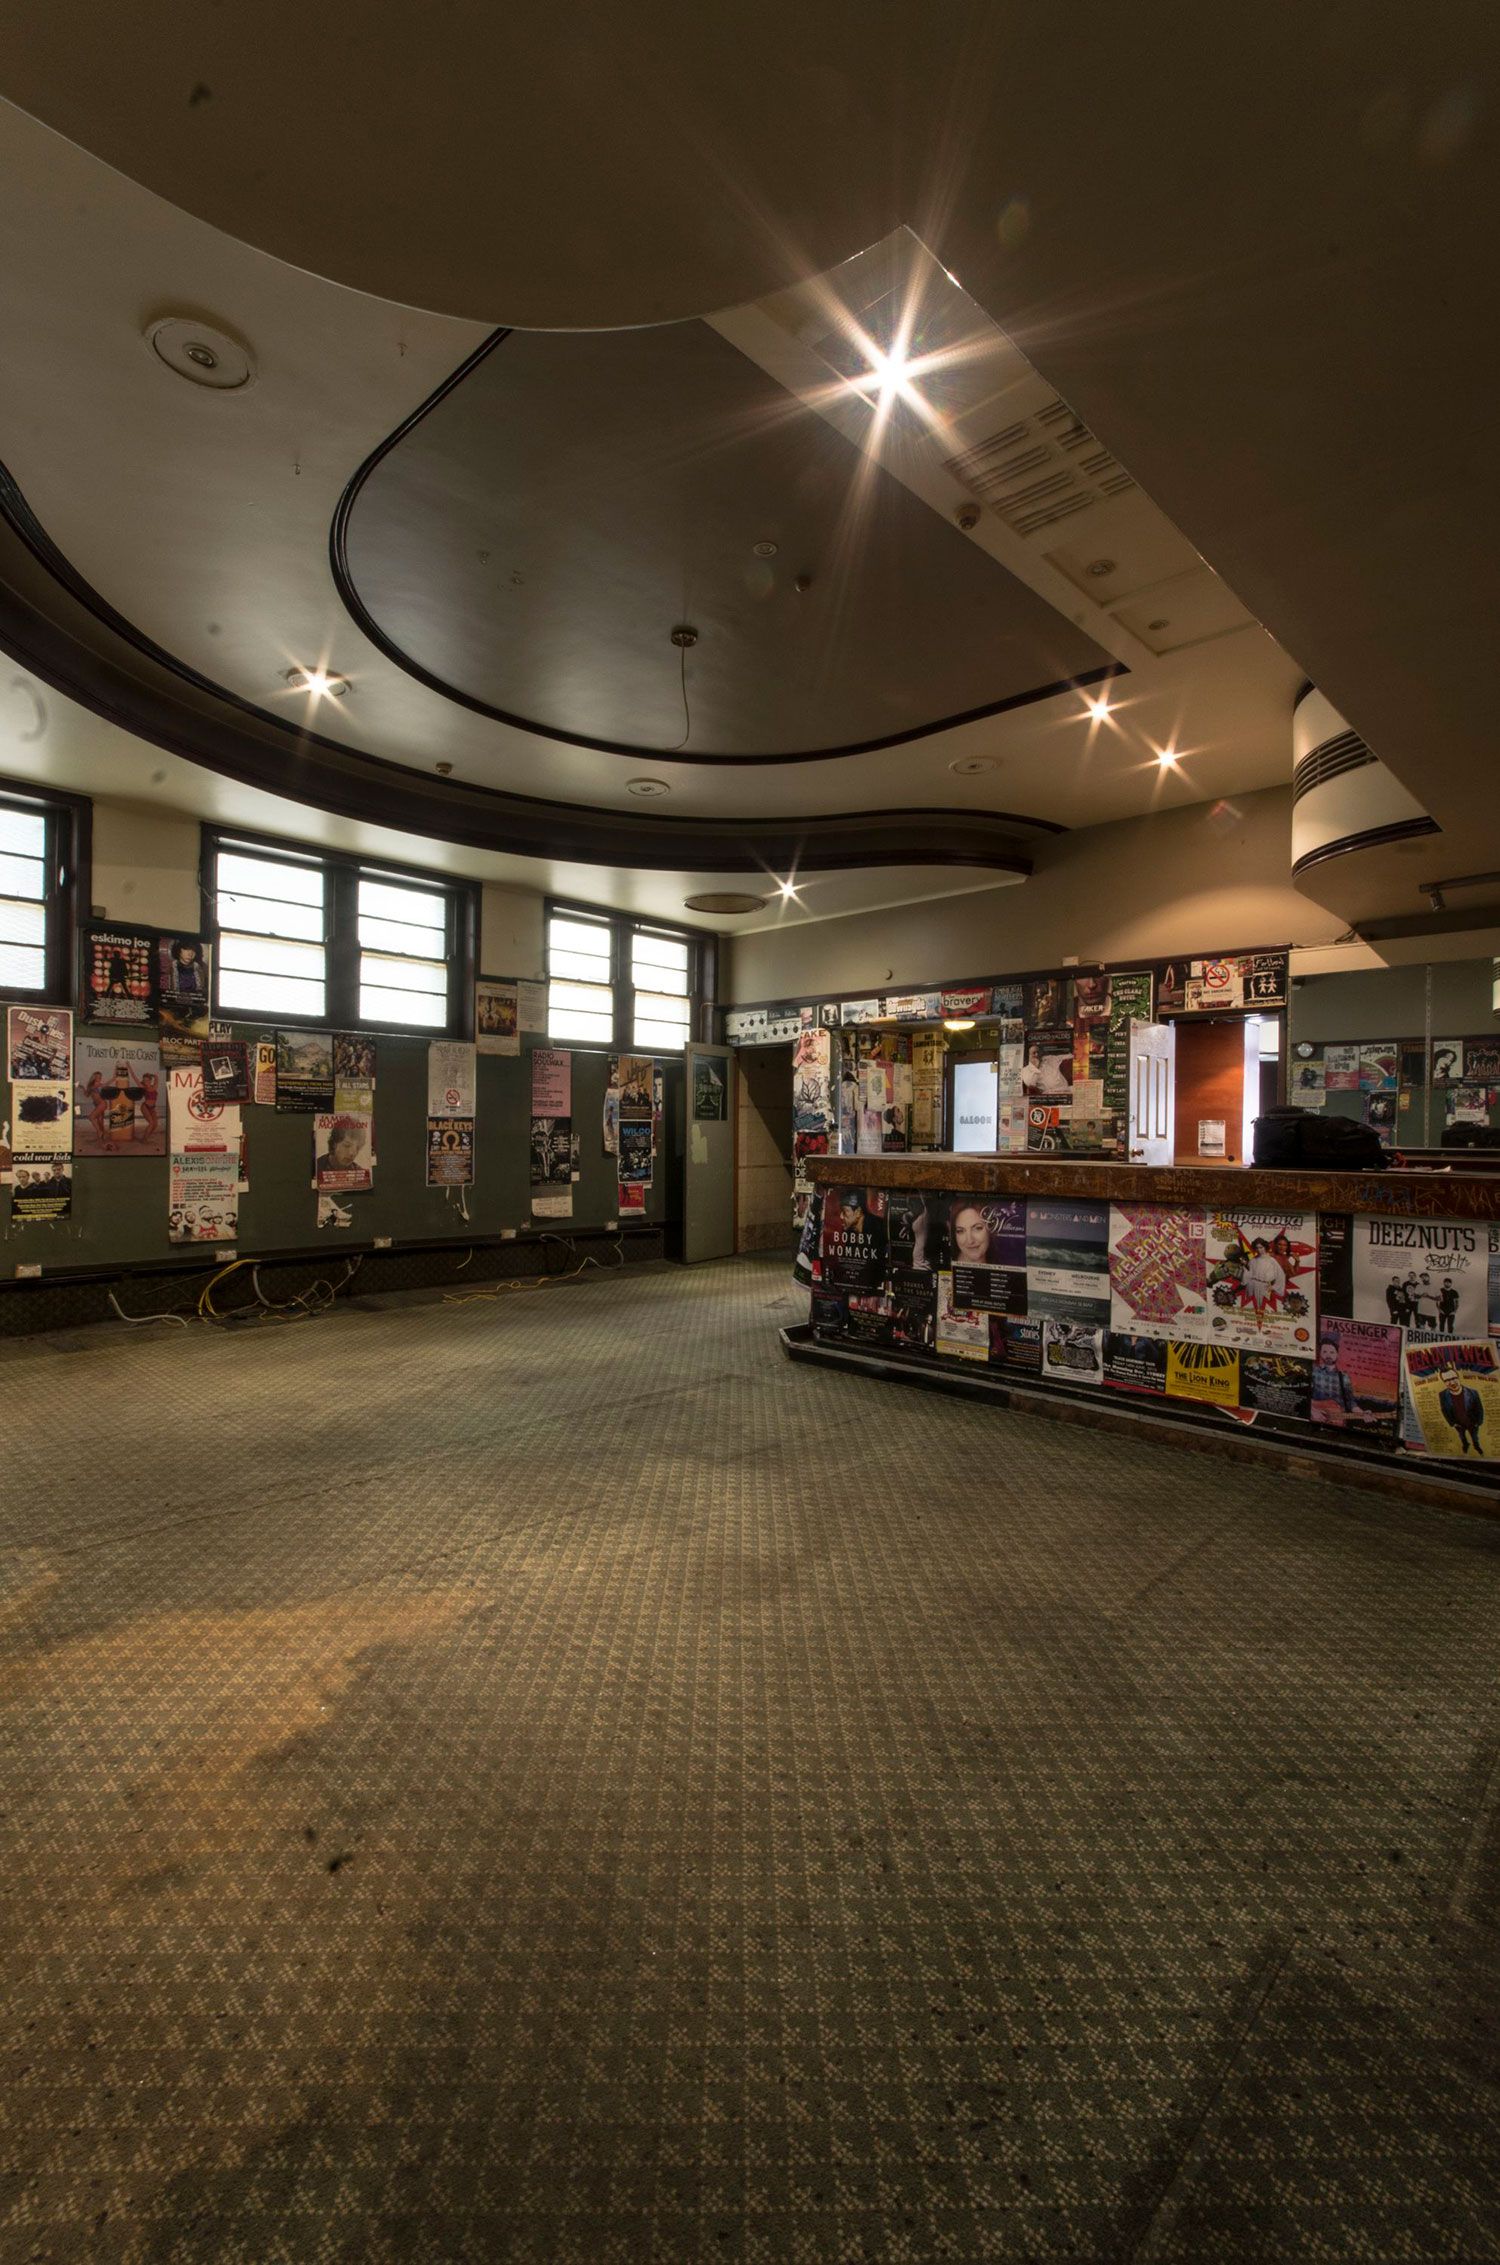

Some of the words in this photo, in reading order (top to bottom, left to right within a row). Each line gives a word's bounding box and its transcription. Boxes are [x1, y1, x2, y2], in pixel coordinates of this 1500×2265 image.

[91, 933, 131, 946] eskimo
[134, 937, 151, 949] joe
[209, 1022, 232, 1034] PLAY
[87, 1046, 108, 1058] TOAST
[110, 1047, 119, 1058] OF
[121, 1047, 136, 1059] THE
[136, 1048, 158, 1061] COAST
[319, 1115, 351, 1123] JAMES
[960, 1115, 992, 1125] SALOON
[623, 1127, 650, 1136] WILCO
[13, 1152, 34, 1162] cold
[34, 1154, 52, 1162] war
[53, 1152, 71, 1161] kids
[1221, 1212, 1303, 1228] supanova
[834, 1231, 872, 1245] BOBBY
[828, 1245, 878, 1260] WOMACK
[1326, 1320, 1389, 1339] PASSENGER
[1175, 1371, 1189, 1379] THE
[1189, 1372, 1207, 1383] LION
[1209, 1376, 1230, 1388] KING
